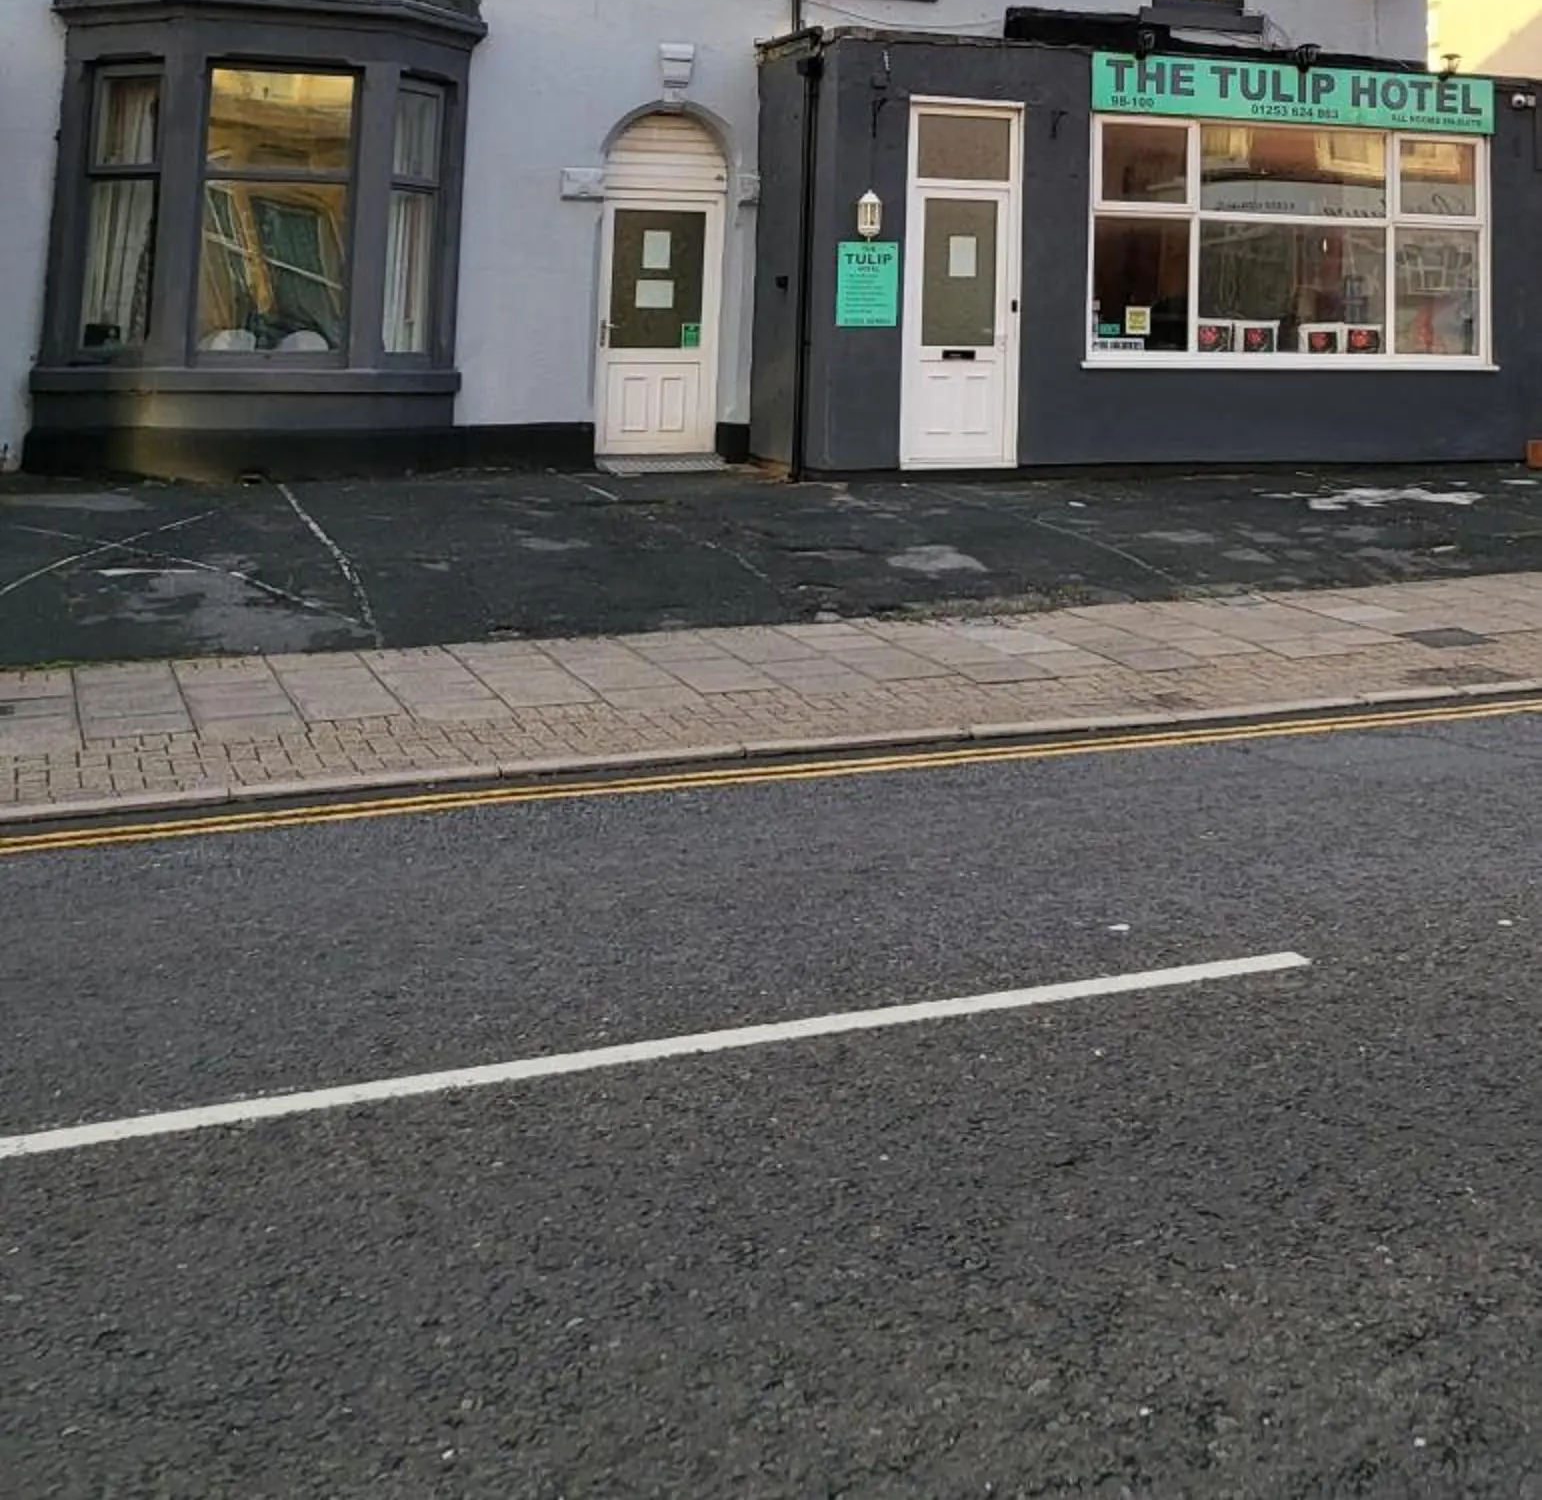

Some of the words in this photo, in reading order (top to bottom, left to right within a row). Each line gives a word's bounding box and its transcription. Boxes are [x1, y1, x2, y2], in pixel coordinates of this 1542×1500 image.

[1106, 59, 1195, 97] THE
[1210, 66, 1336, 105] TULIP
[1351, 75, 1483, 116] HOTEL
[1250, 104, 1288, 116] 01253
[844, 253, 893, 265] TULIP
